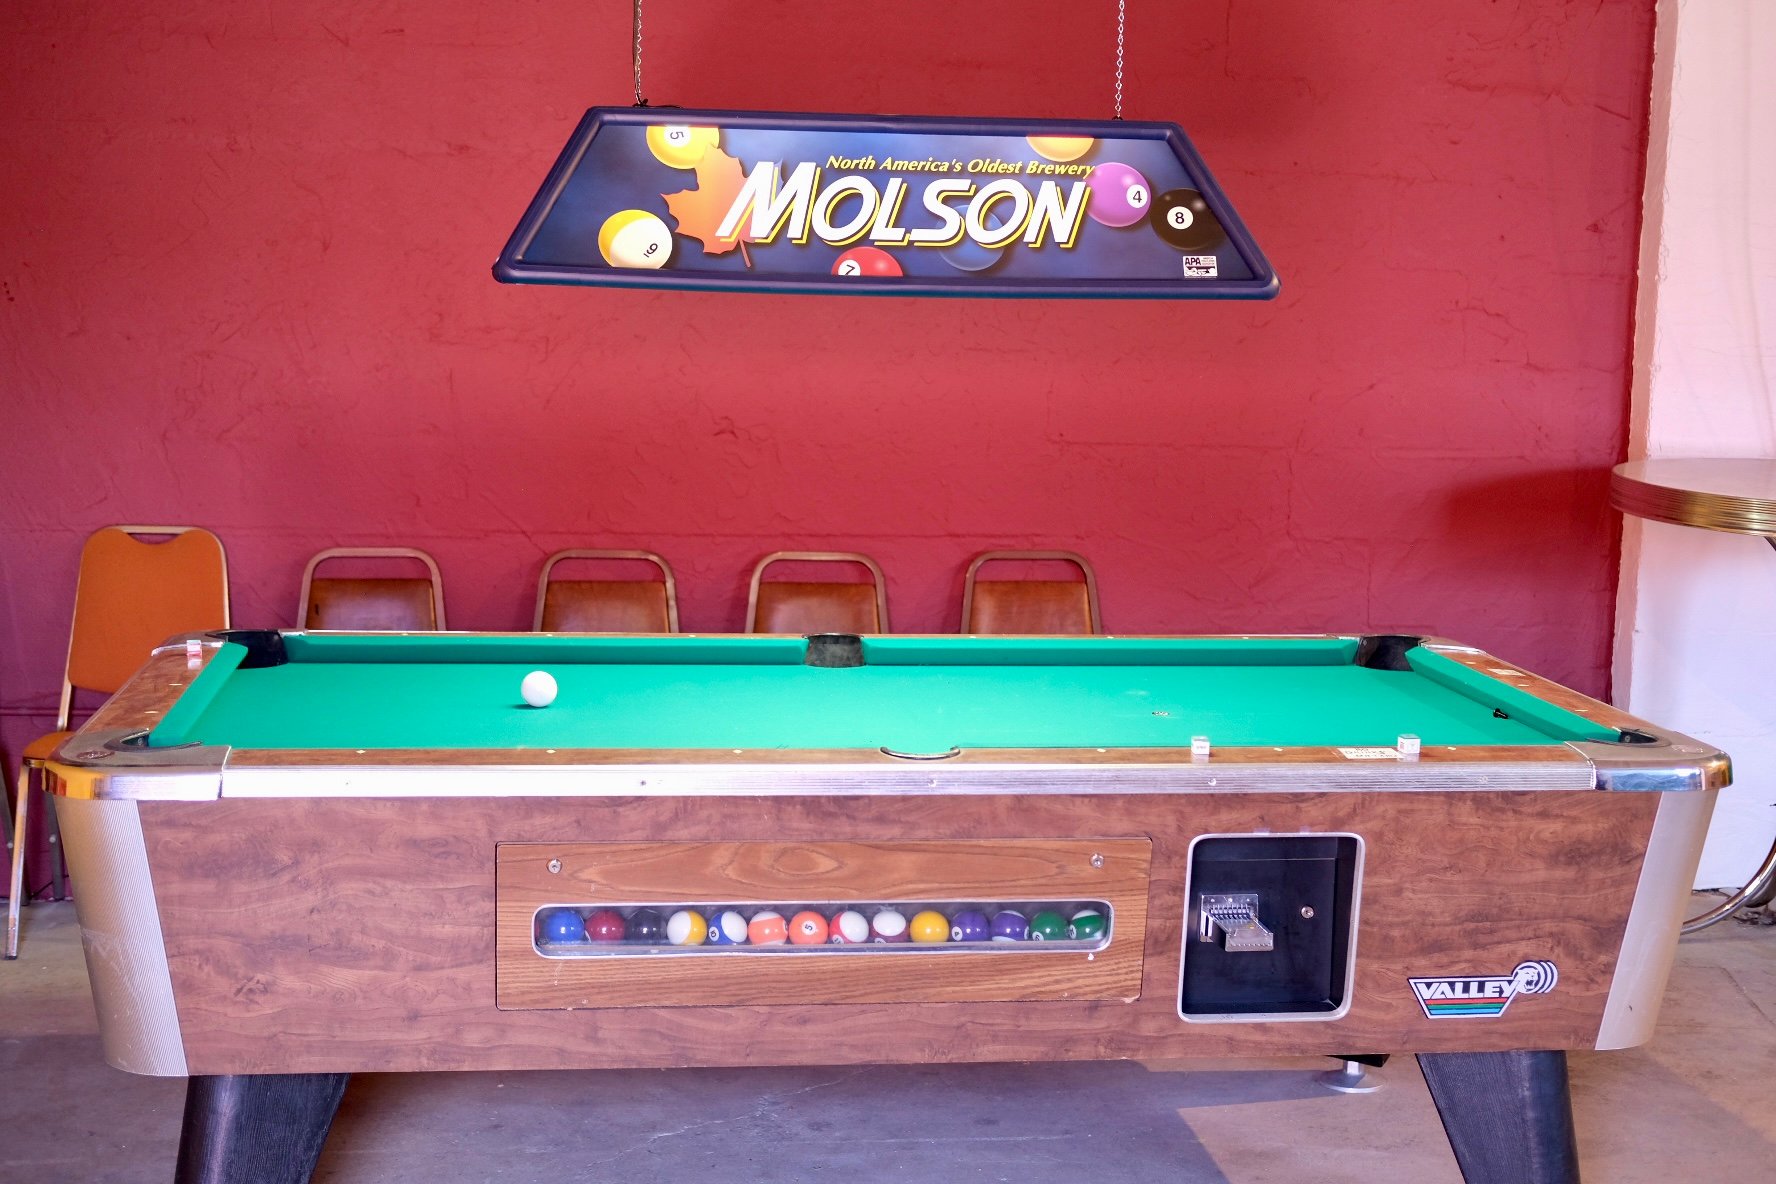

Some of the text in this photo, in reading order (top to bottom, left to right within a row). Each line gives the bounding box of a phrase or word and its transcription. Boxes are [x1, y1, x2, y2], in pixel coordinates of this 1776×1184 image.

[669, 131, 684, 140] 5
[826, 155, 1095, 179] North America's Oldest Brewery
[1132, 190, 1143, 204] 4
[715, 161, 1091, 248] MOLSON
[1175, 211, 1185, 224] 8
[644, 242, 659, 257] 9
[1185, 257, 1201, 266] APA
[845, 263, 856, 275] 7
[1416, 980, 1518, 999] VALLEY
